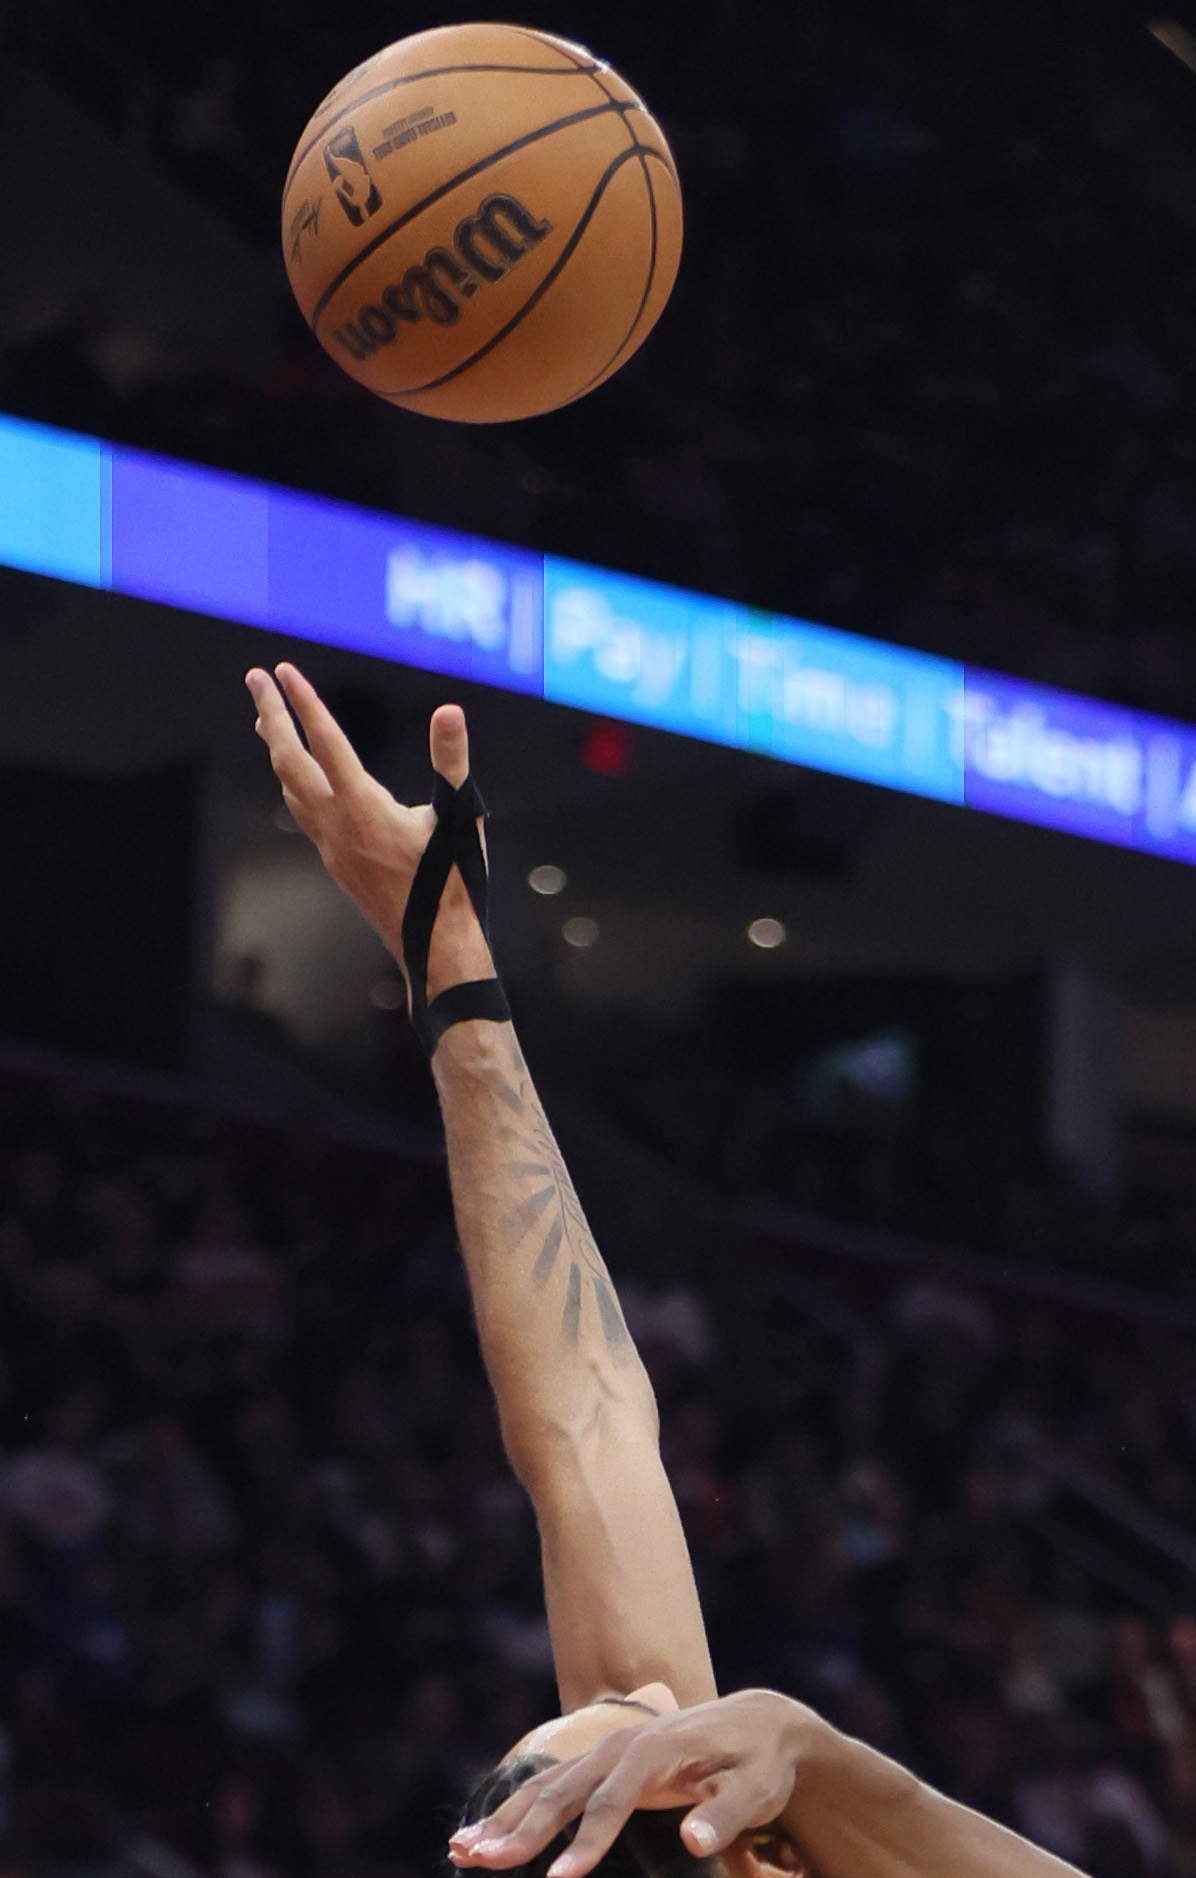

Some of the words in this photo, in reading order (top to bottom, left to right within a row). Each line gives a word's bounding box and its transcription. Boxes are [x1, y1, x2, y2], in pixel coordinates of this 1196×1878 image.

[333, 193, 554, 362] Wilson
[386, 544, 505, 651] HR
[550, 587, 686, 707] Pay
[732, 632, 896, 750] Time
[948, 689, 1143, 816] Talent
